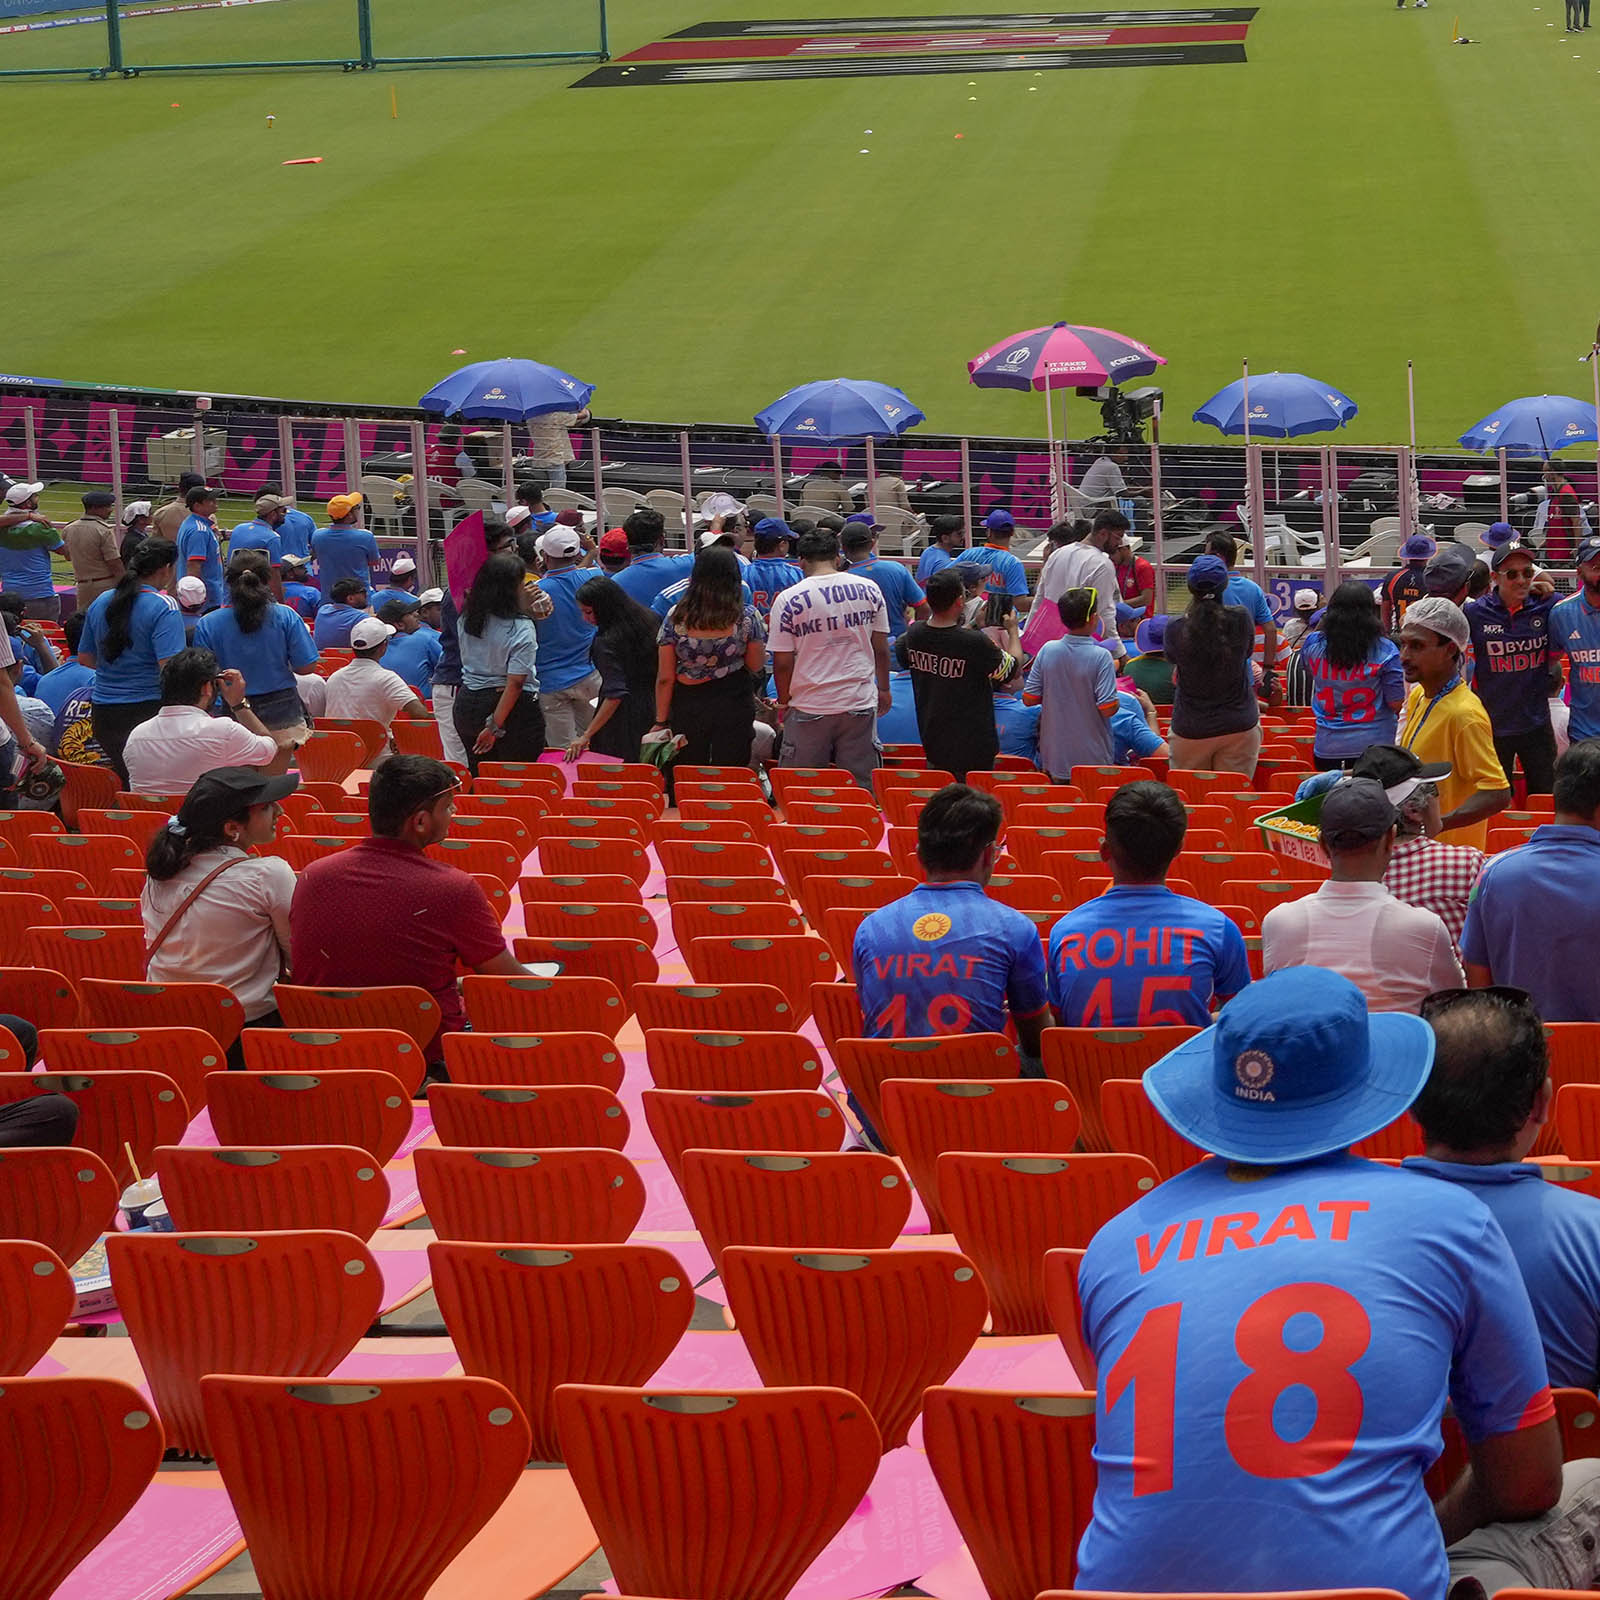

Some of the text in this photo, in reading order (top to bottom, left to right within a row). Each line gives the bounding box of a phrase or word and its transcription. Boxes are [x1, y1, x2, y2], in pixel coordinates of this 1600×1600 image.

[826, 616, 838, 631] IT
[906, 647, 966, 679] AME ON
[1309, 657, 1383, 682] VIRAT
[1490, 650, 1545, 673] INDIA
[1317, 686, 1377, 723] 18
[1281, 833, 1316, 862] Ice Tea
[1060, 926, 1205, 973] ROHIT
[873, 953, 986, 981] VIRAT
[1234, 1085, 1276, 1103] INDIA
[1134, 1200, 1372, 1276] VIRAT
[1104, 1281, 1372, 1498] 18
